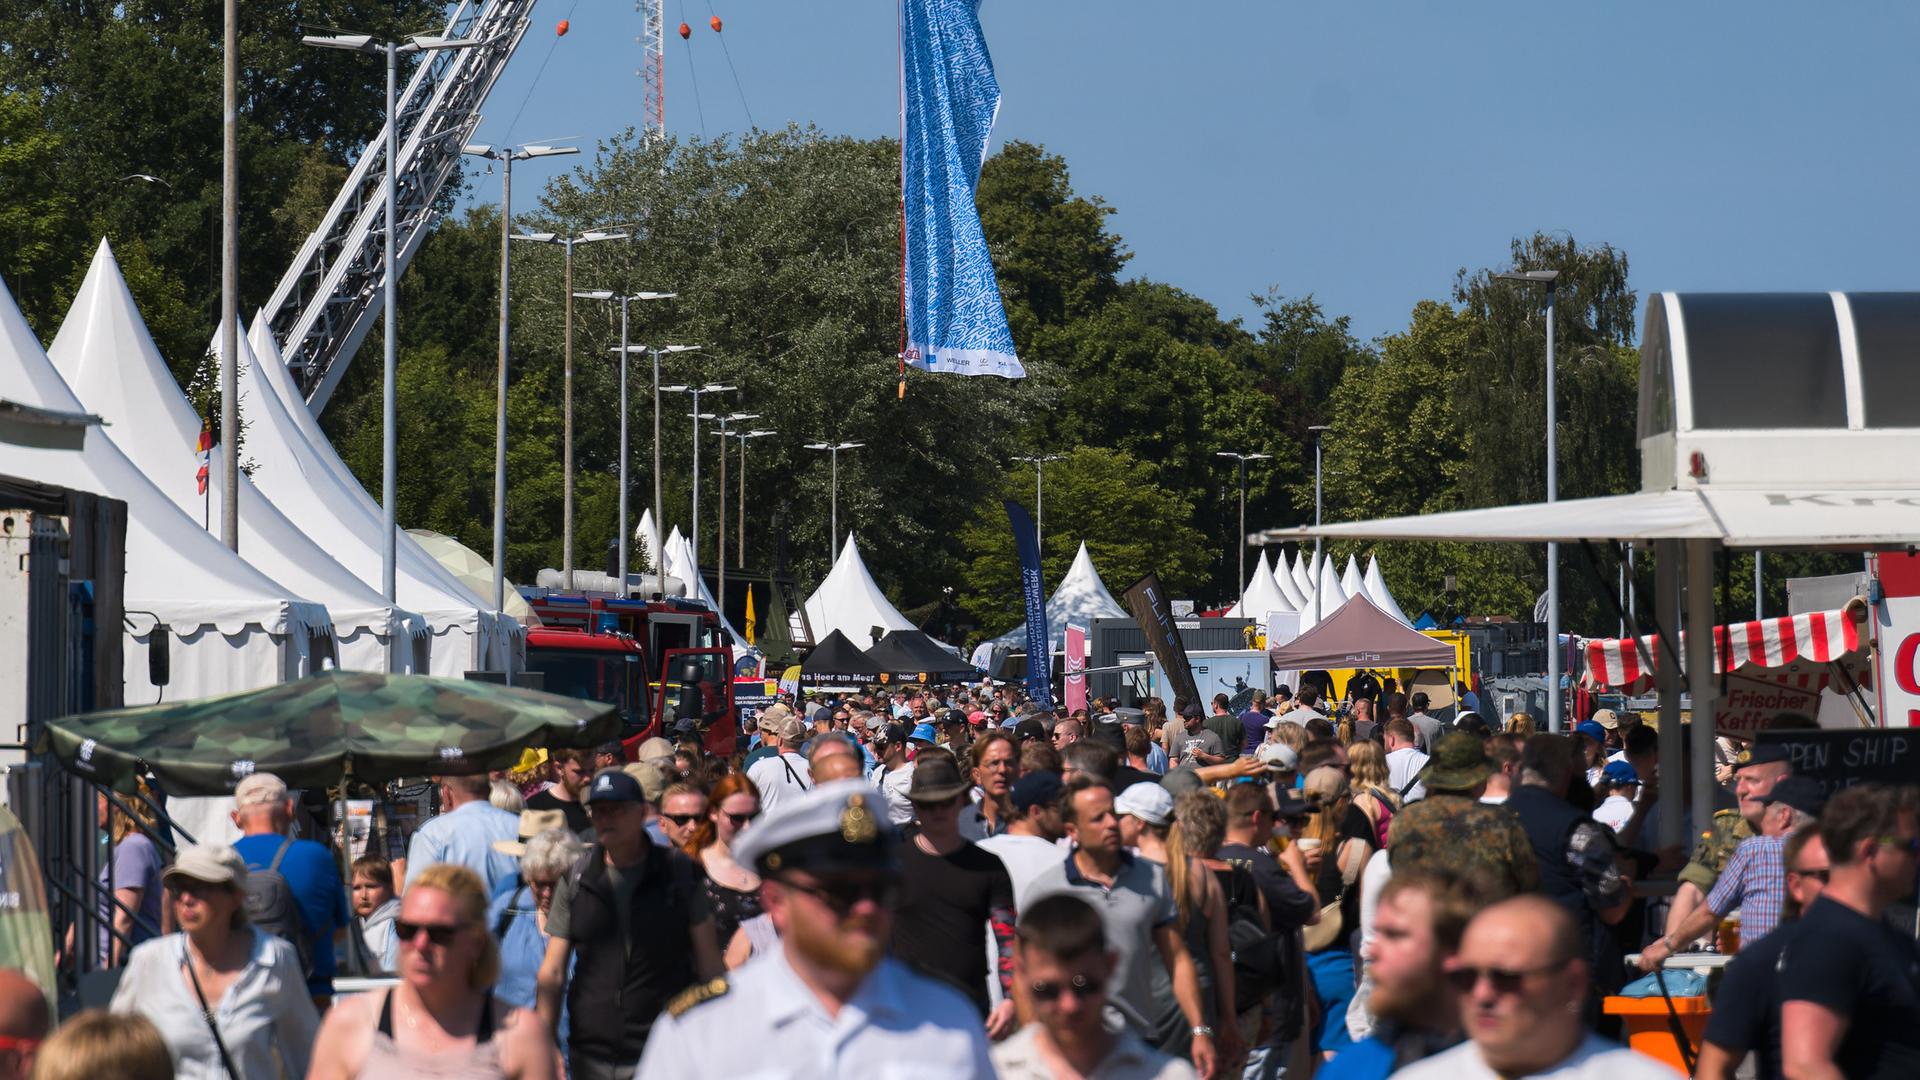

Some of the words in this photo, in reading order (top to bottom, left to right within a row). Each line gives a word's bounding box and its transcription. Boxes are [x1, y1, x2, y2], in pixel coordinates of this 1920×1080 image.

[946, 357, 970, 366] WELLER
[814, 672, 835, 681] Heer
[853, 673, 876, 682] Meer
[1727, 688, 1809, 709] Frischer
[1715, 710, 1771, 730] Kaffe
[1842, 736, 1909, 768] SHIP
